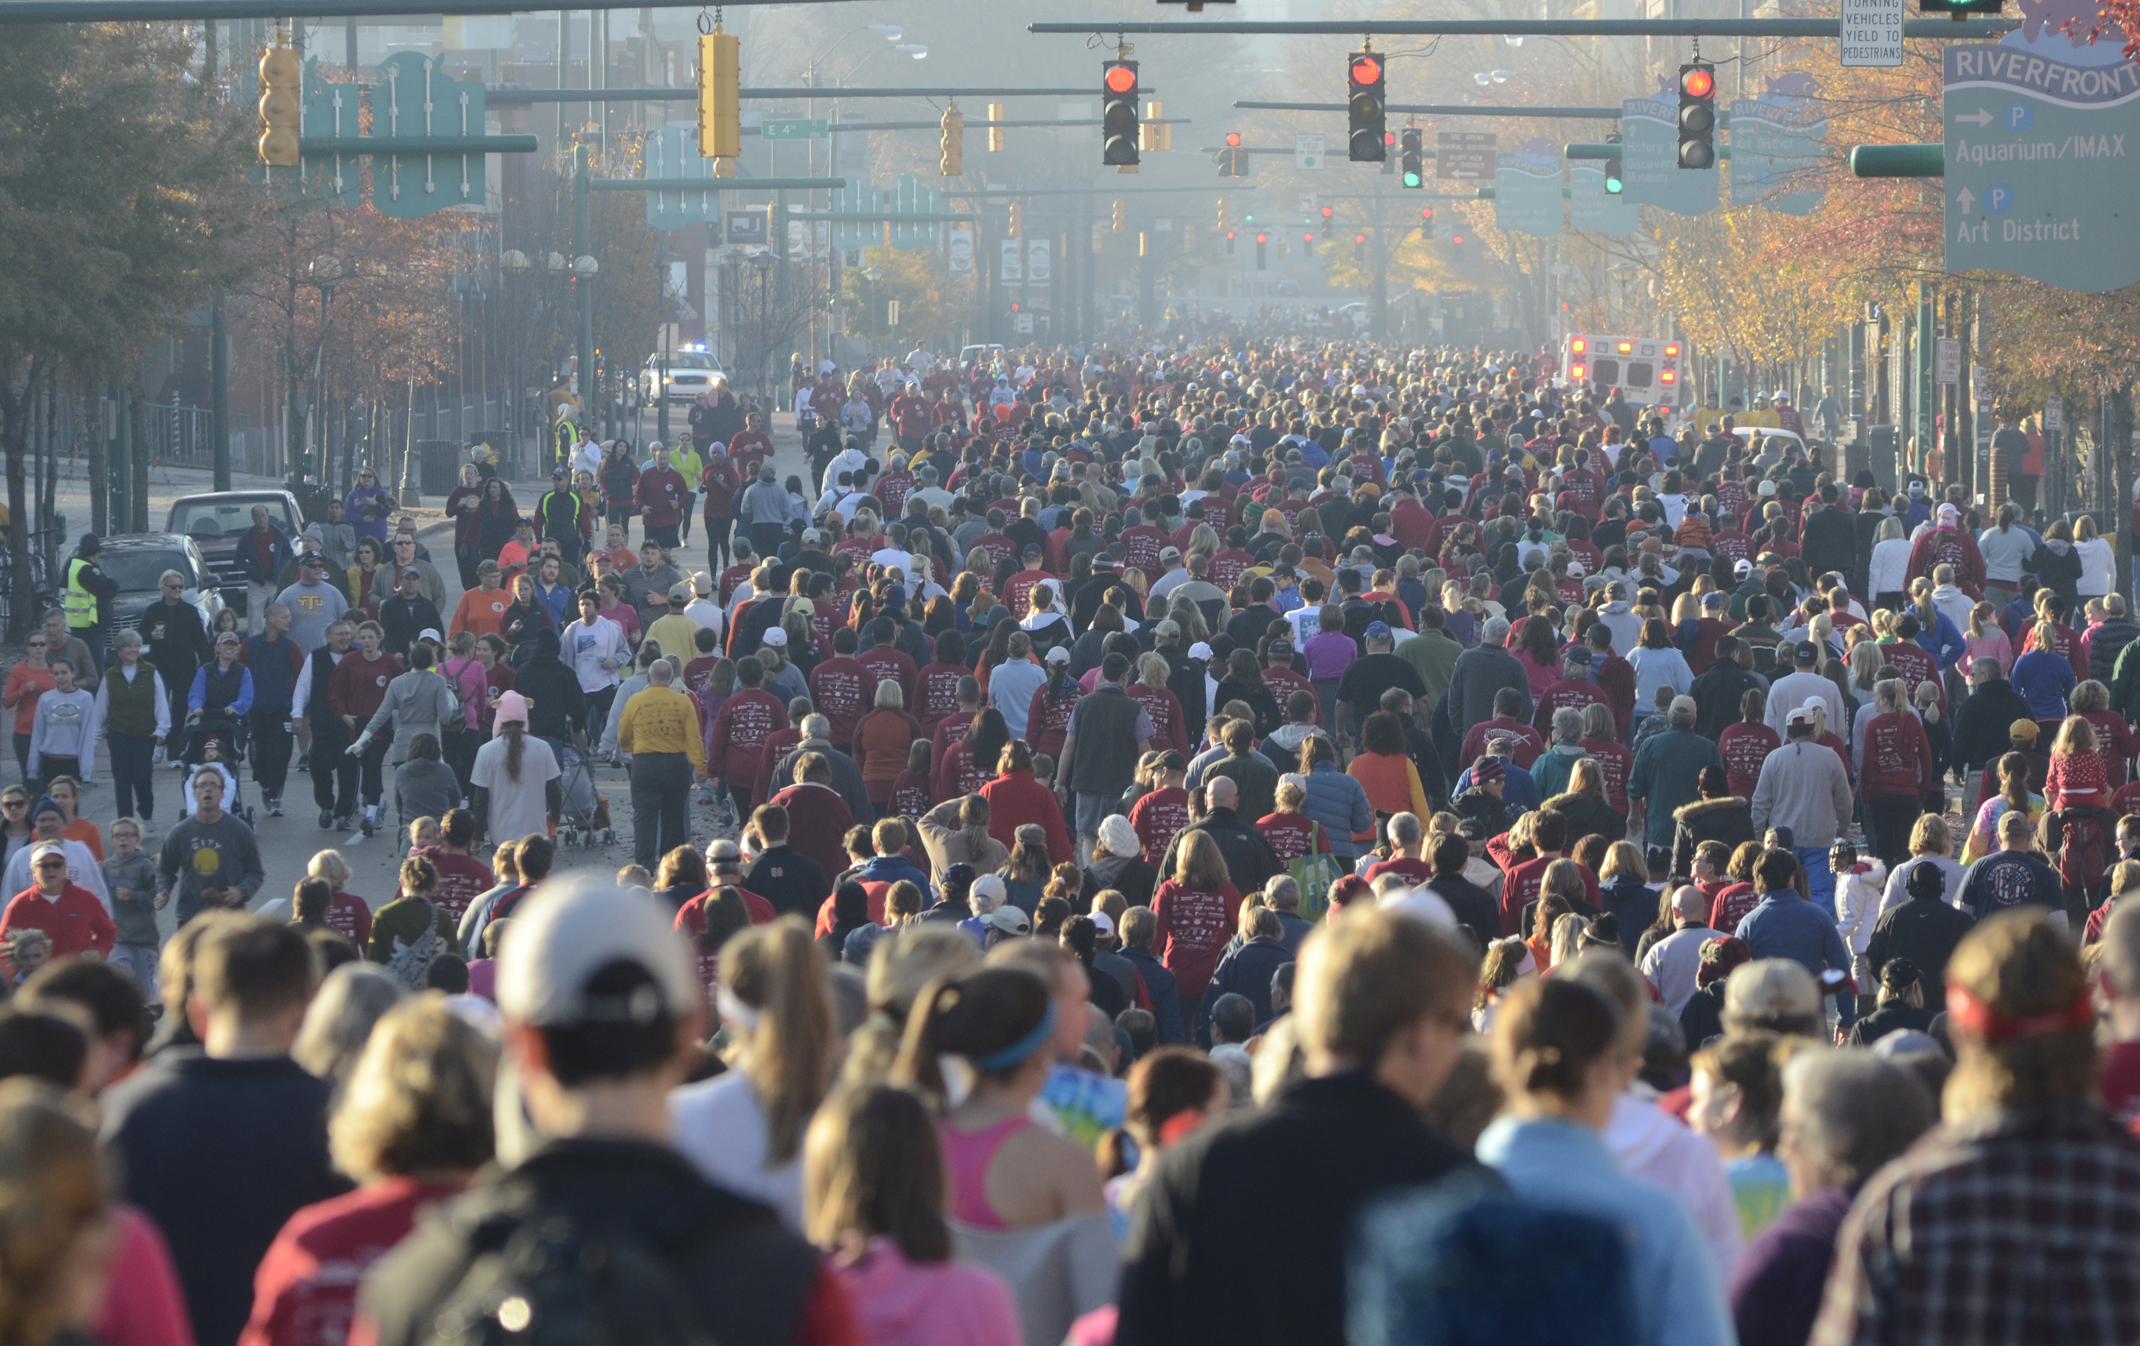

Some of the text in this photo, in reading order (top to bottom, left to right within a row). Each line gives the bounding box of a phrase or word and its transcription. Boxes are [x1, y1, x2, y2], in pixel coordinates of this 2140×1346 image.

[1846, 14, 1899, 26] VEHICLES
[1846, 30, 1899, 42] YIELD TO
[1843, 46, 1901, 59] PEDESTRIANS
[1956, 51, 2140, 96] RIVERFRONT
[1627, 101, 1678, 121] RIVERF
[769, 124, 776, 136] E
[1627, 142, 1664, 155] History
[1736, 138, 1793, 149] Art District
[1956, 135, 2125, 167] Aquarium/IMAX
[1499, 157, 1560, 175] RIVERFRONT
[1627, 159, 1677, 171] Discovery
[1627, 173, 1667, 183] Museum
[1957, 218, 2080, 243] Art District
